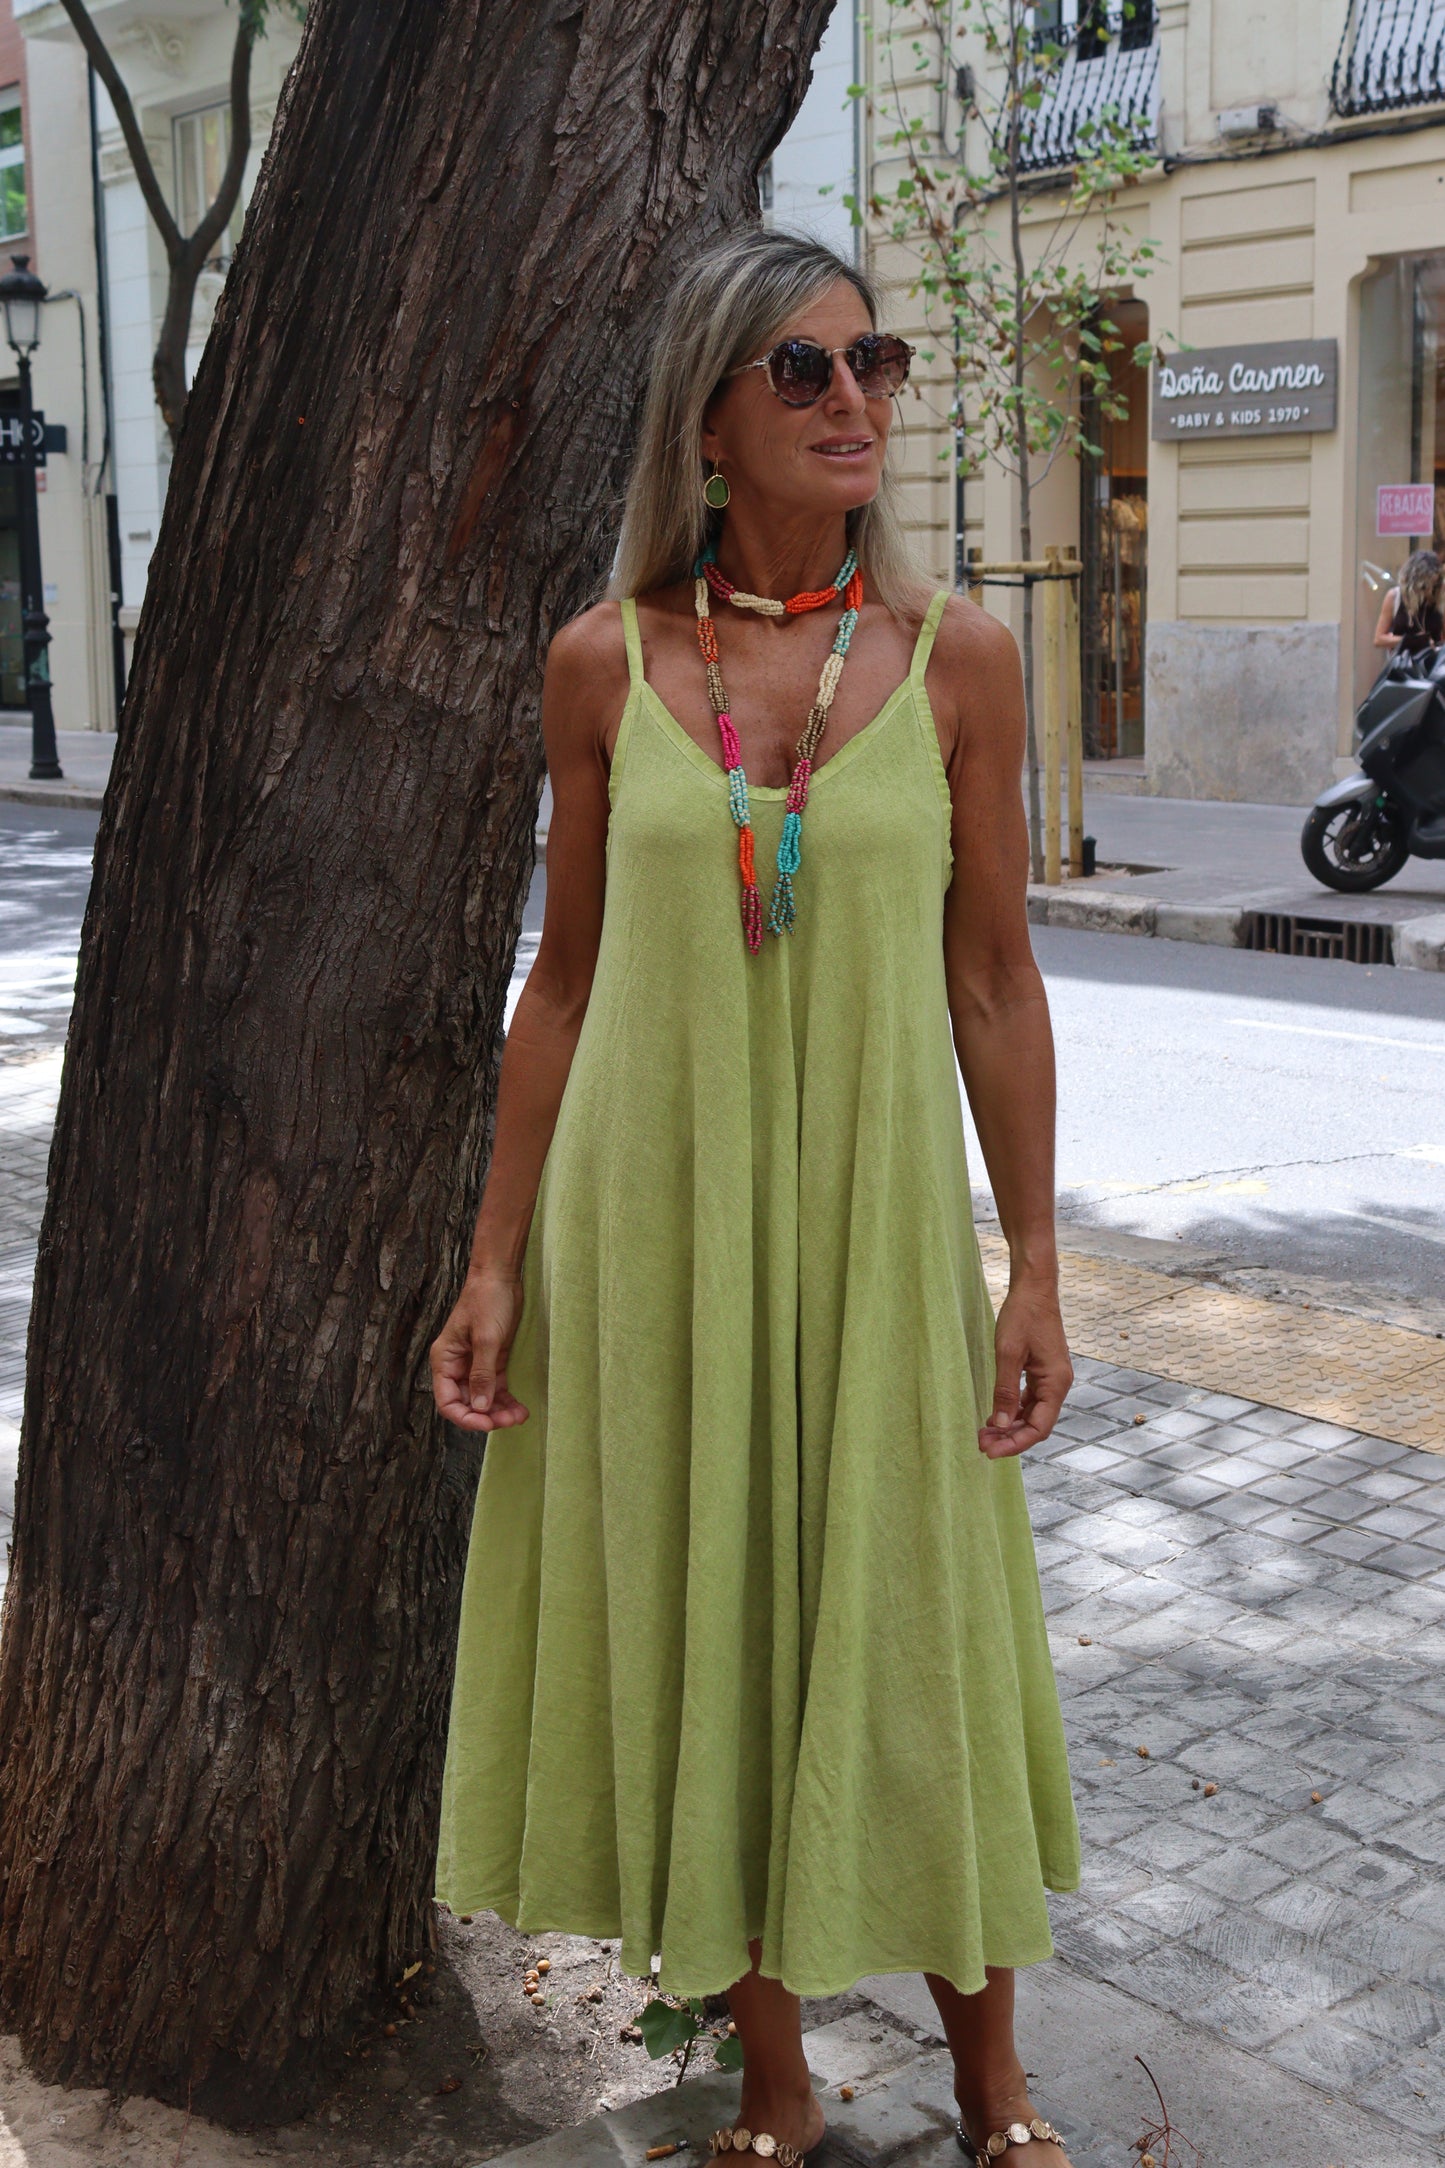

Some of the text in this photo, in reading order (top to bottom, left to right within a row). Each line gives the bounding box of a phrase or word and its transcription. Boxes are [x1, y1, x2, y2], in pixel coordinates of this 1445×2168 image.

[1158, 362, 1324, 398] Doña Carmen
[1177, 406, 1300, 428] BABY & KIDS 1970
